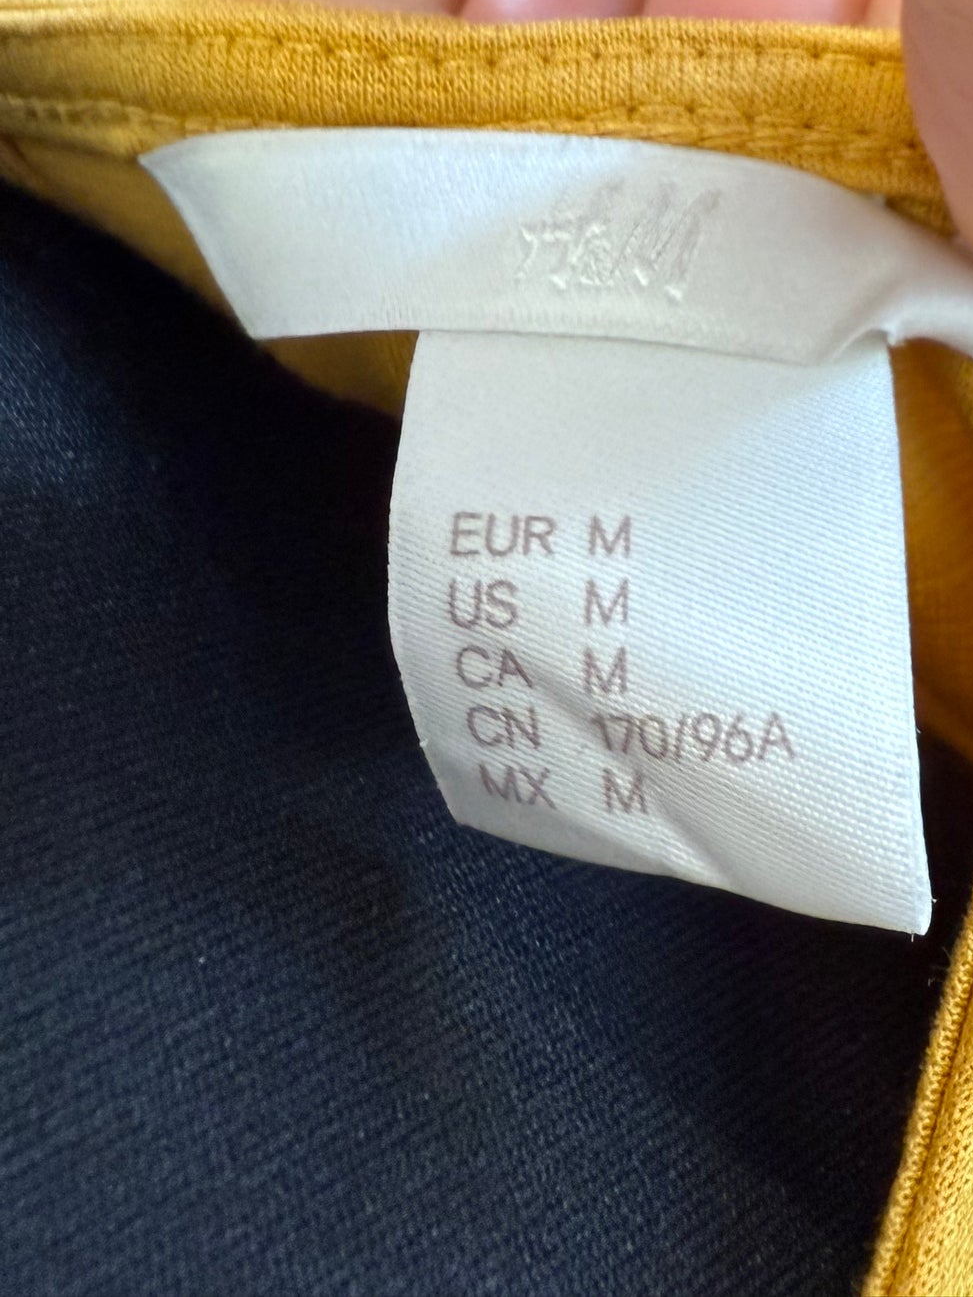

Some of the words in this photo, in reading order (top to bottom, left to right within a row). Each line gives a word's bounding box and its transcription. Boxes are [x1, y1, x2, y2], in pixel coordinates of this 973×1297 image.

[450, 511, 556, 557] EUR
[588, 515, 631, 558] M
[448, 577, 518, 628] US
[584, 578, 629, 626] M
[456, 645, 532, 688] CA
[582, 647, 627, 695] M
[467, 705, 542, 749] CN
[592, 711, 796, 762] 170/96A
[480, 763, 556, 810] MX
[602, 768, 648, 814] M
